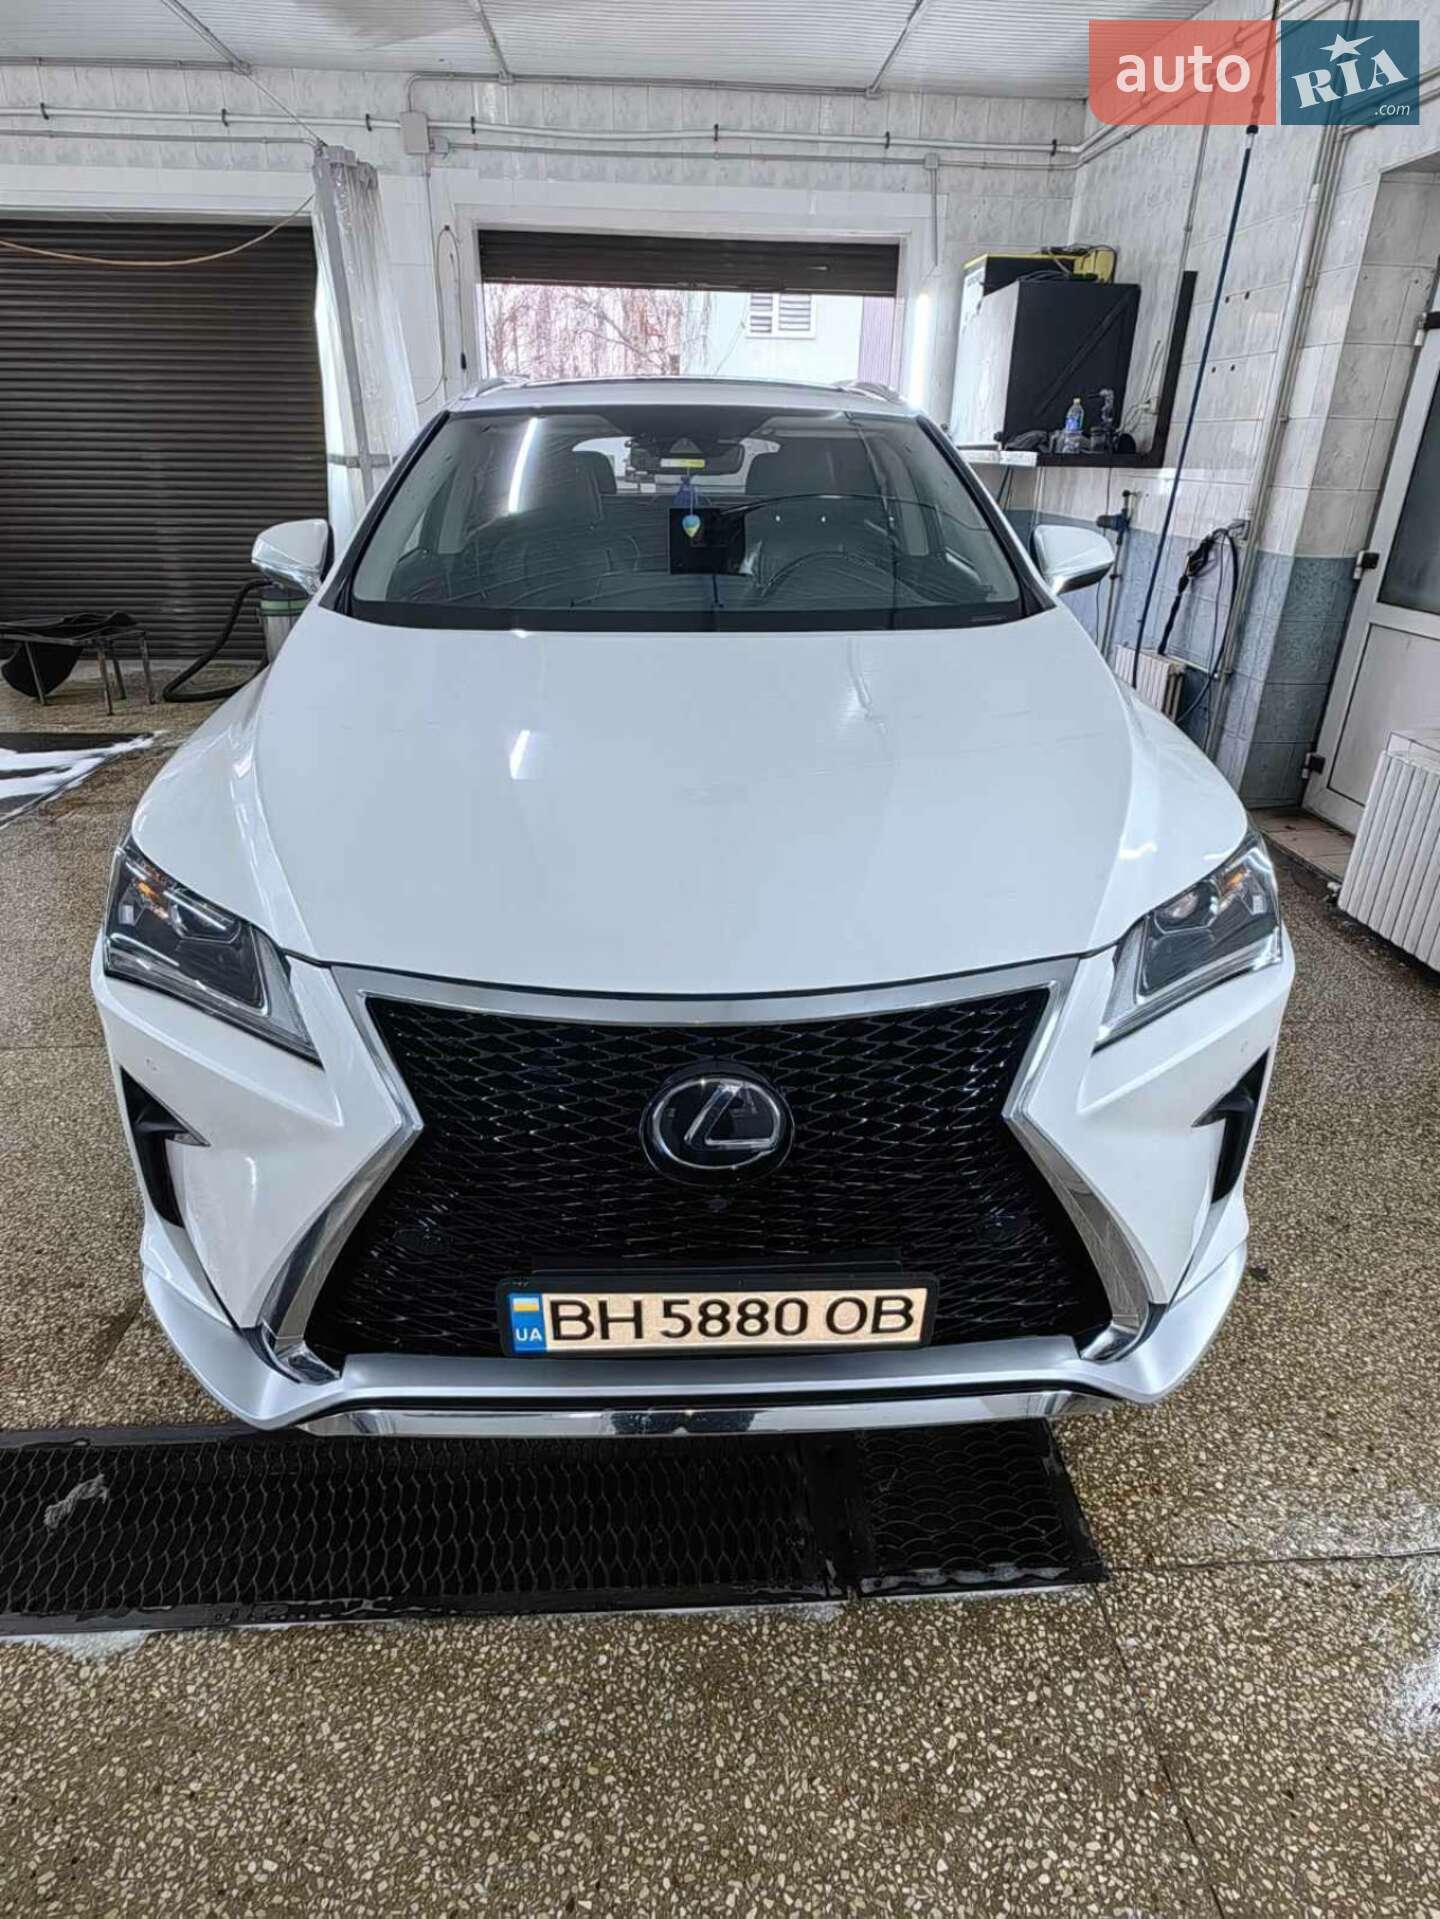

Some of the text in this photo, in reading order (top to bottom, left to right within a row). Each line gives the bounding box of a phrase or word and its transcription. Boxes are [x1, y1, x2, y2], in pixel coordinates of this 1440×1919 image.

[549, 1295, 915, 1341] BH 5880 OB
[515, 1328, 543, 1342] UA
